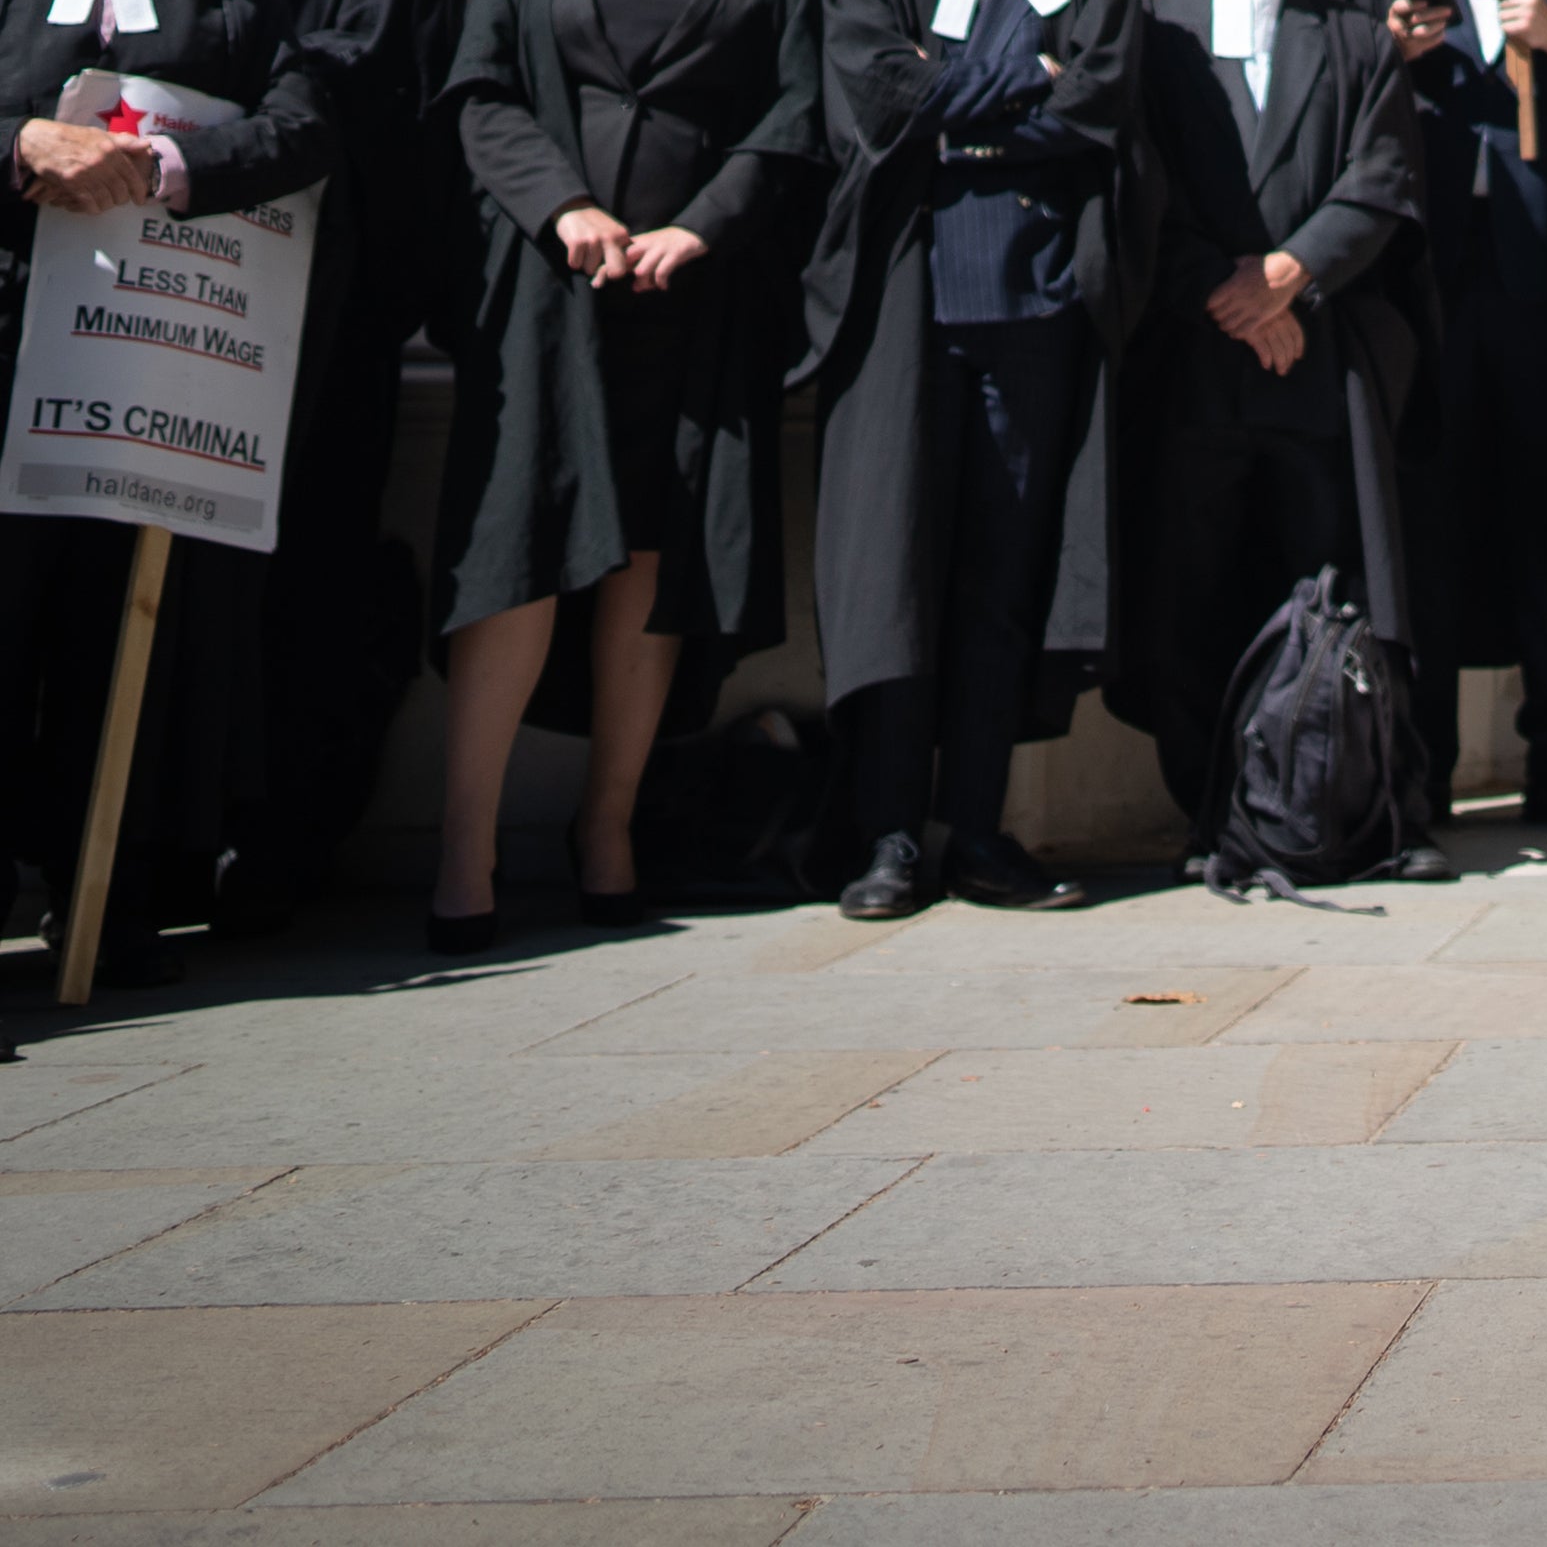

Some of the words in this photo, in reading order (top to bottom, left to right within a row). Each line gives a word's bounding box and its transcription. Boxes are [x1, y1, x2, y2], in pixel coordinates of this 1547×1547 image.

[142, 218, 243, 261] EARNING
[116, 260, 187, 295] LESS
[197, 273, 248, 313] THAN
[73, 305, 197, 348] MINIMUM
[203, 325, 265, 367] WAGE
[32, 397, 112, 432] IT'S
[124, 405, 266, 466] CRIMINAL
[85, 471, 217, 521] haldane.org
